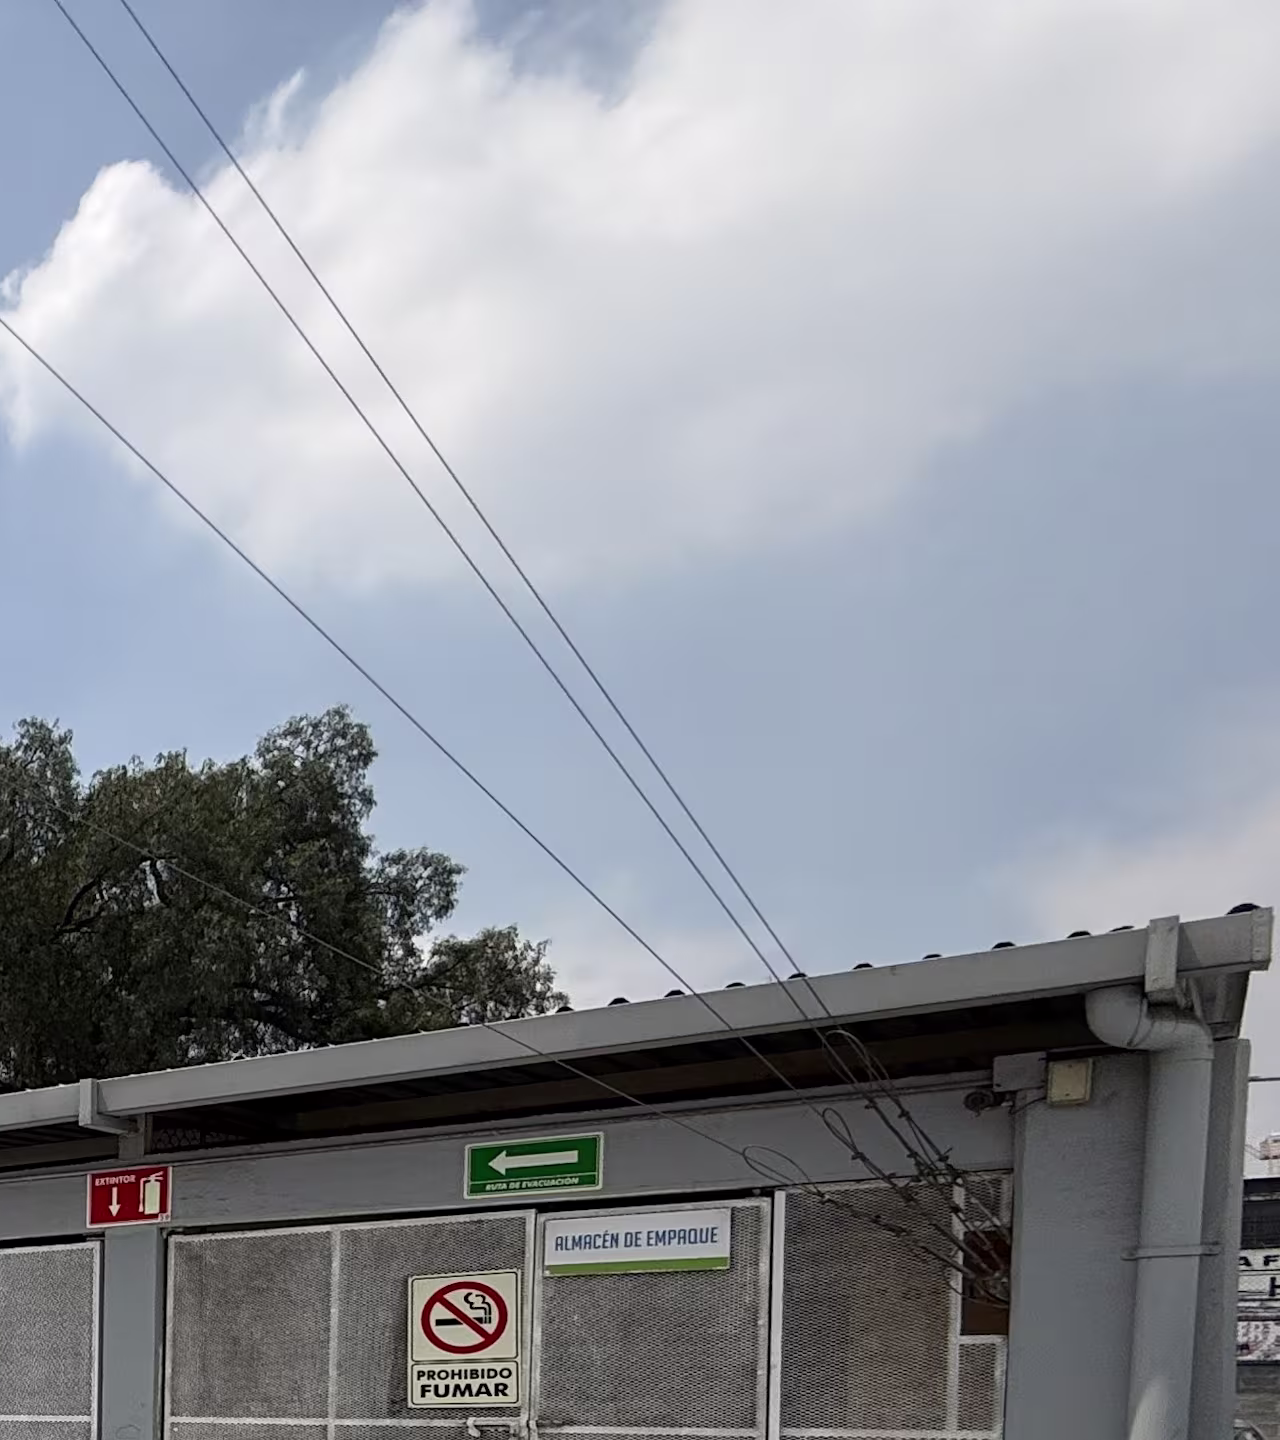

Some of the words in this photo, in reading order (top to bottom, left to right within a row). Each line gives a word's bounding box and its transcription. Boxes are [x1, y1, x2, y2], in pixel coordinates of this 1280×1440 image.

[95, 1175, 136, 1186] EXTINTOR
[486, 1182, 508, 1191] RUTA
[509, 1181, 521, 1189] DE
[555, 1230, 619, 1251] ALMACÉN
[624, 1231, 642, 1247] DE
[647, 1226, 719, 1246] EMPAQUE
[416, 1367, 512, 1381] PROHIBIDO
[420, 1383, 509, 1398] FUMAR
